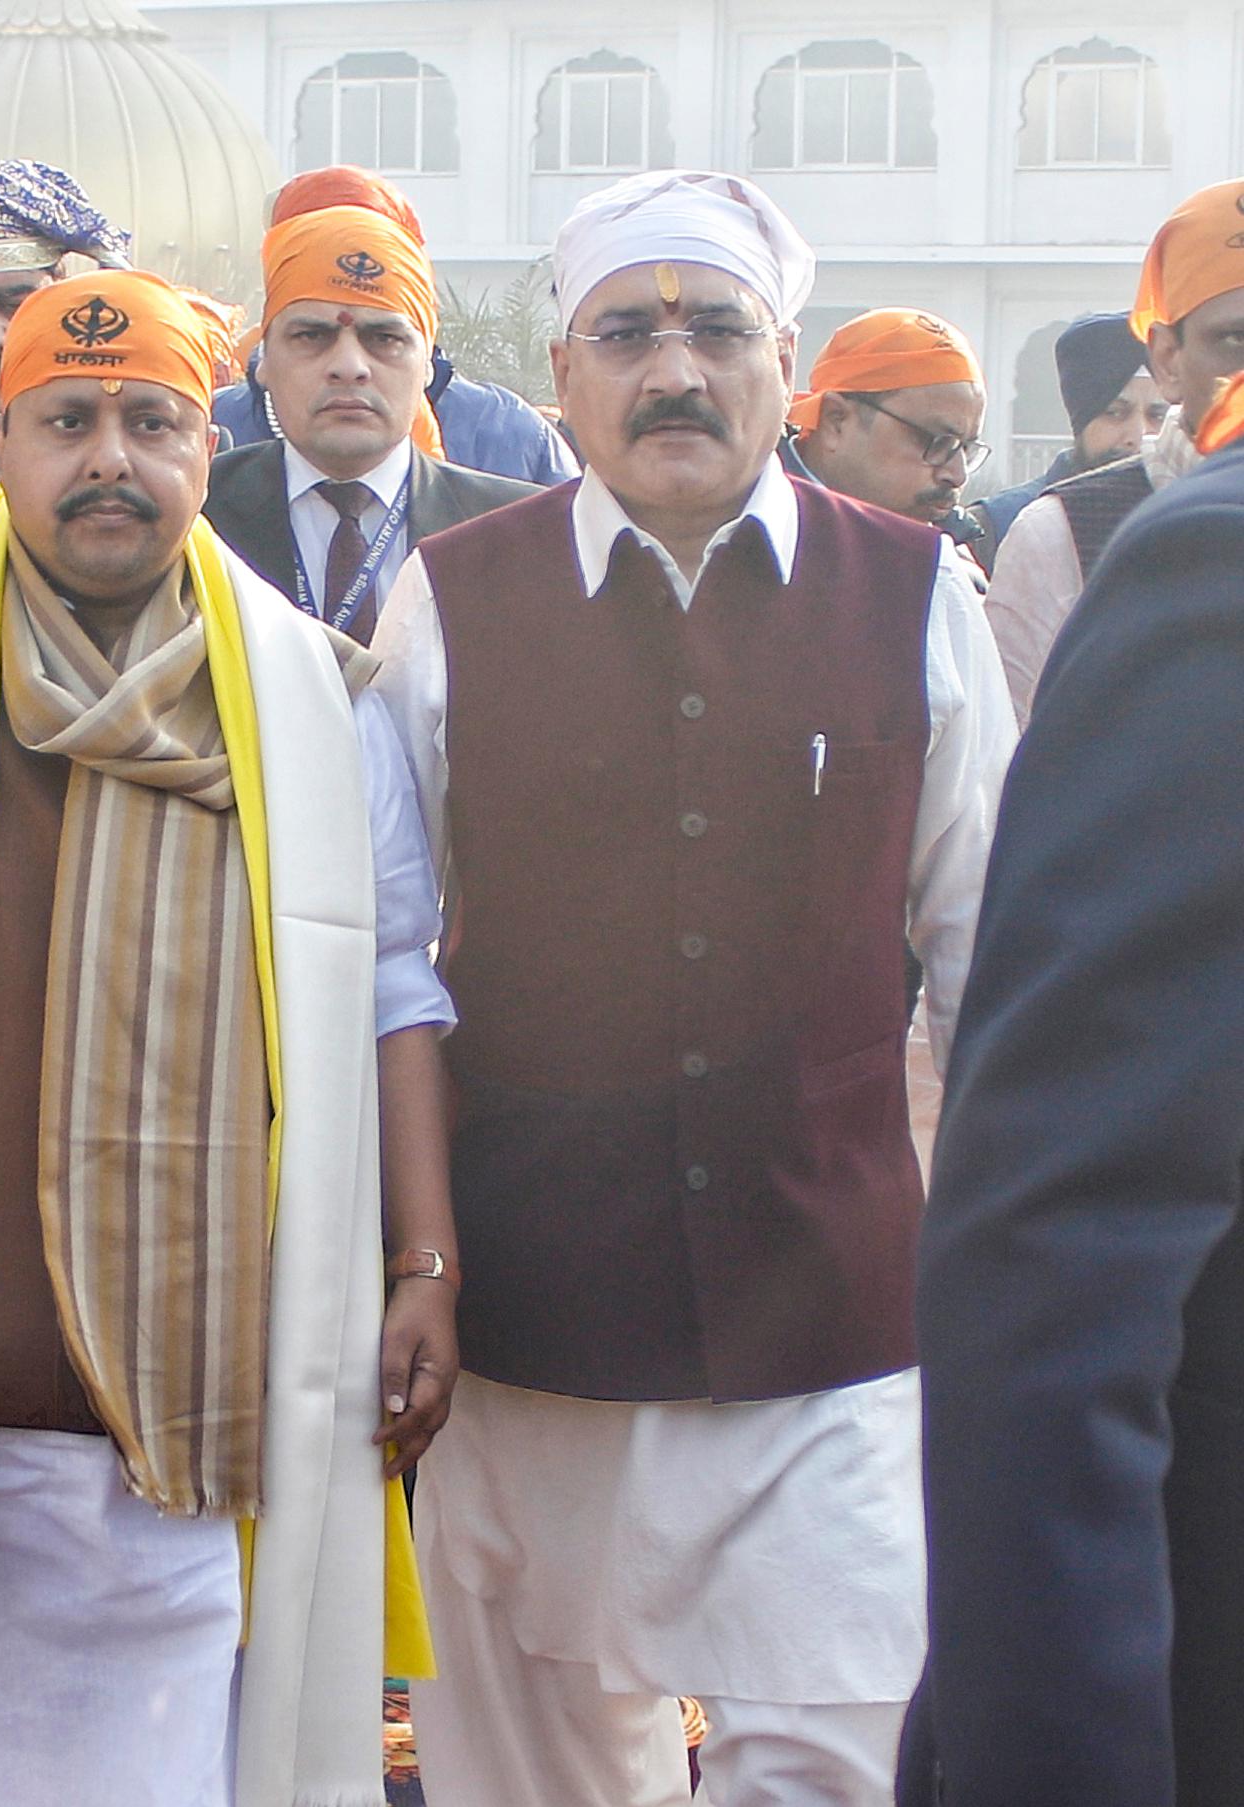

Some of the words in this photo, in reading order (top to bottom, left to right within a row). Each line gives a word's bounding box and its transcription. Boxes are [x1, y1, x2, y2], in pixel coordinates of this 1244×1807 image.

[342, 572, 369, 605] Wings
[363, 521, 395, 572] MINISTRY
[388, 508, 401, 525] OF
